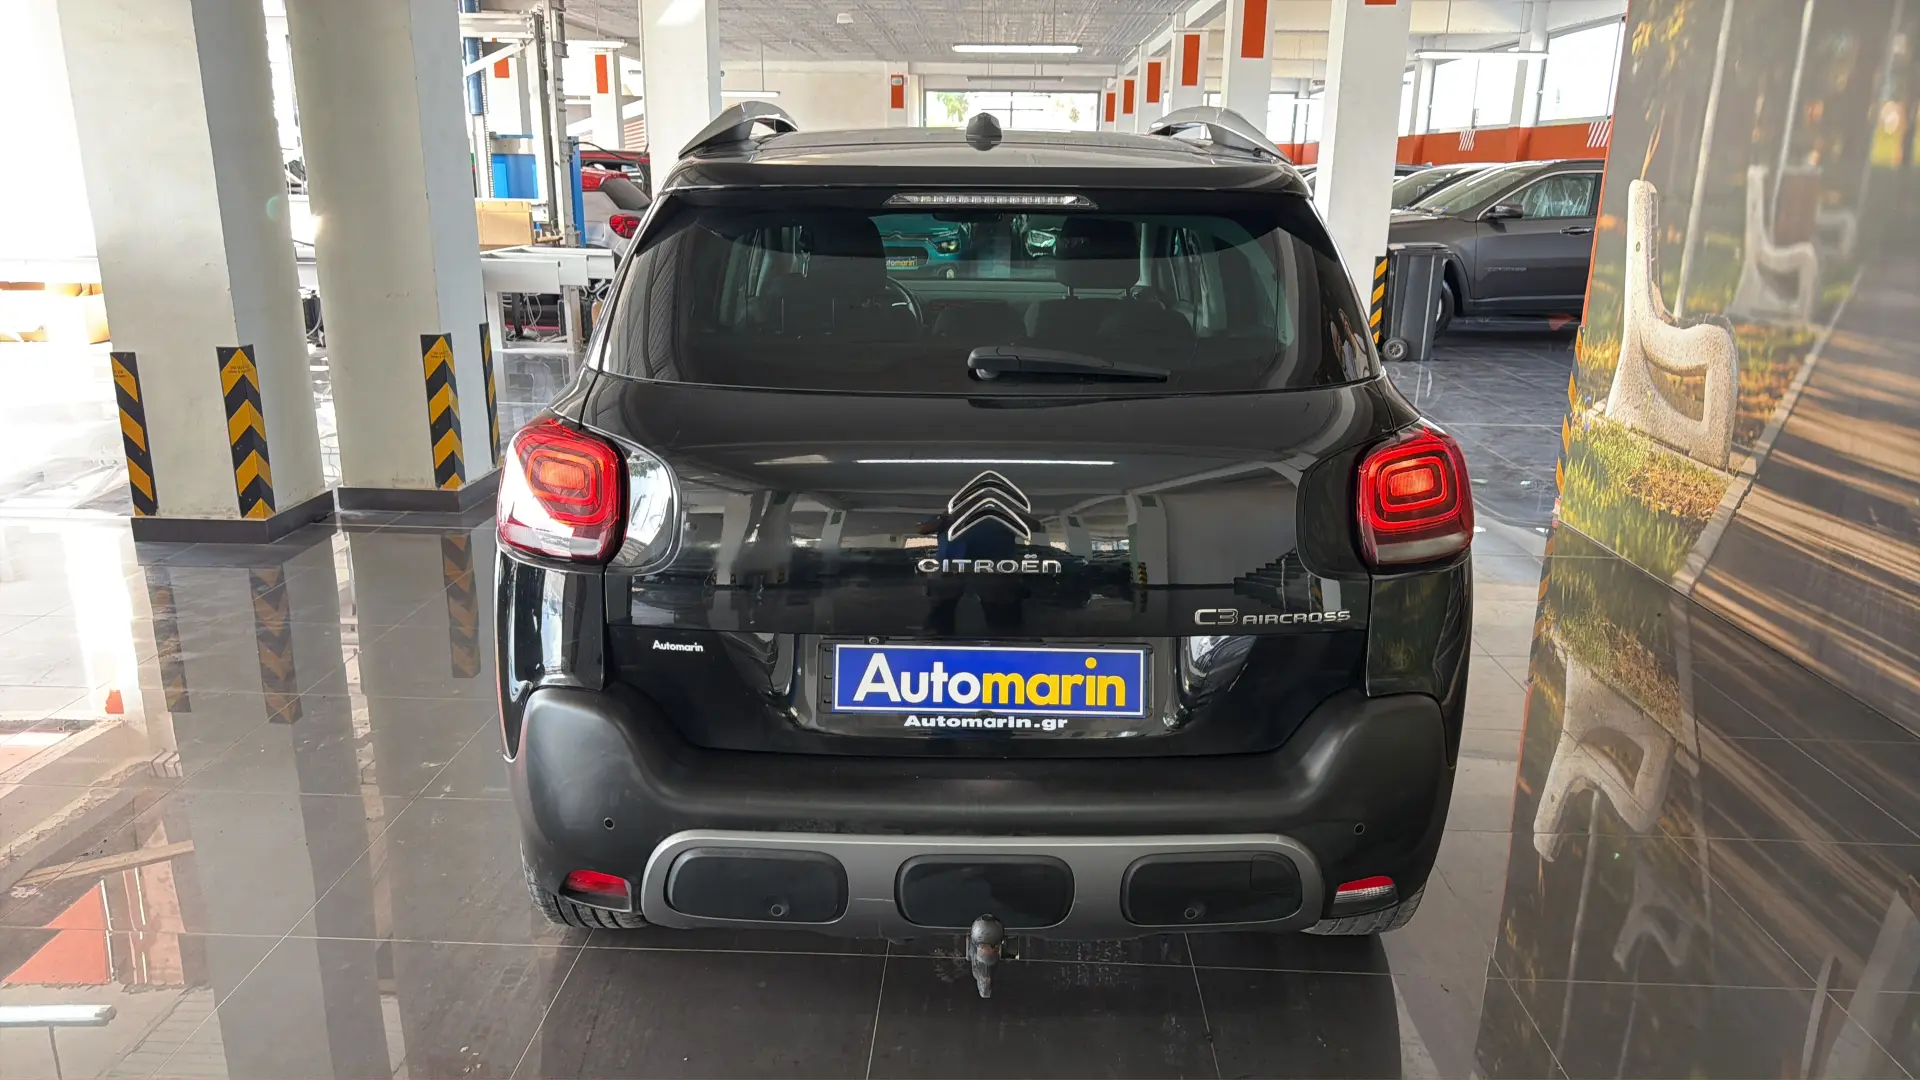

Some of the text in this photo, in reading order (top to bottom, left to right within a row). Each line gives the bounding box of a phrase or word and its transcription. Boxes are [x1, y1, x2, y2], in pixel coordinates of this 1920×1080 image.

[918, 554, 1062, 574] CITROËN
[1194, 608, 1351, 625] C3 AIRCROSS
[652, 639, 704, 652] Automarin
[852, 652, 1126, 706] Automarin
[904, 715, 1068, 730] Automarin.gr
